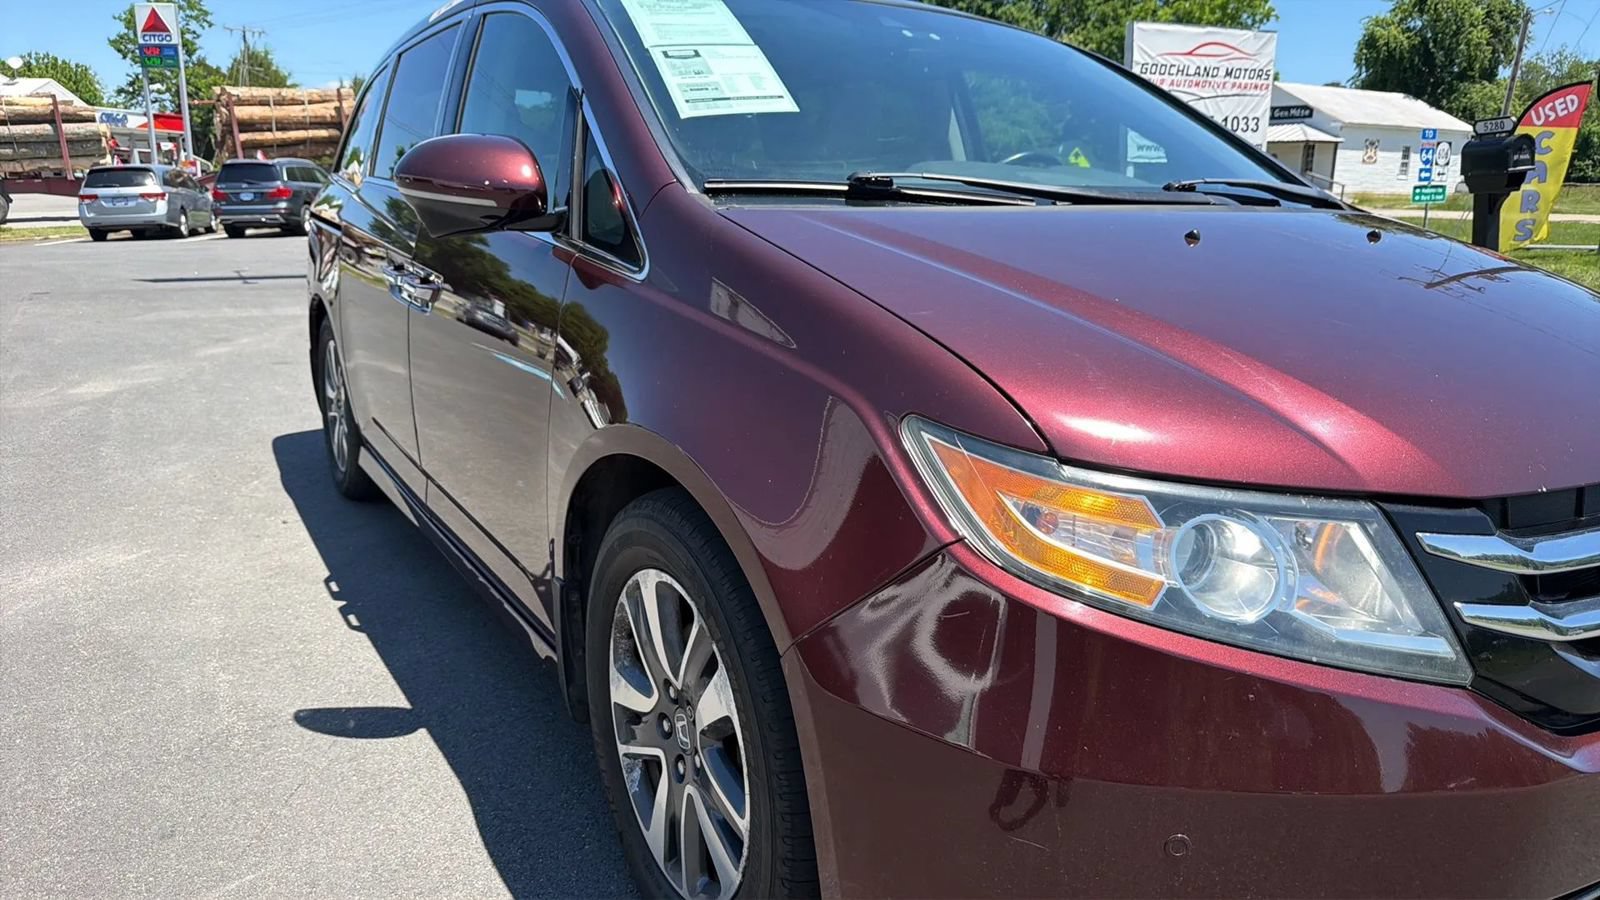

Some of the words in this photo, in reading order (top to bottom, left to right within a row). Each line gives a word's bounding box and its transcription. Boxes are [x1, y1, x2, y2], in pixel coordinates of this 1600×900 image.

[142, 34, 172, 42] CITGO
[1140, 63, 1219, 78] GOOCHLAND
[1224, 67, 1271, 80] MOTORS
[1169, 80, 1227, 89] AUTOMOTIVE
[1231, 82, 1270, 91] PARTNER
[1531, 94, 1579, 126] USED
[1221, 116, 1260, 133] 1033
[1483, 120, 1505, 132] 5280
[1421, 148, 1433, 161] 64
[1513, 130, 1555, 242] CARS
